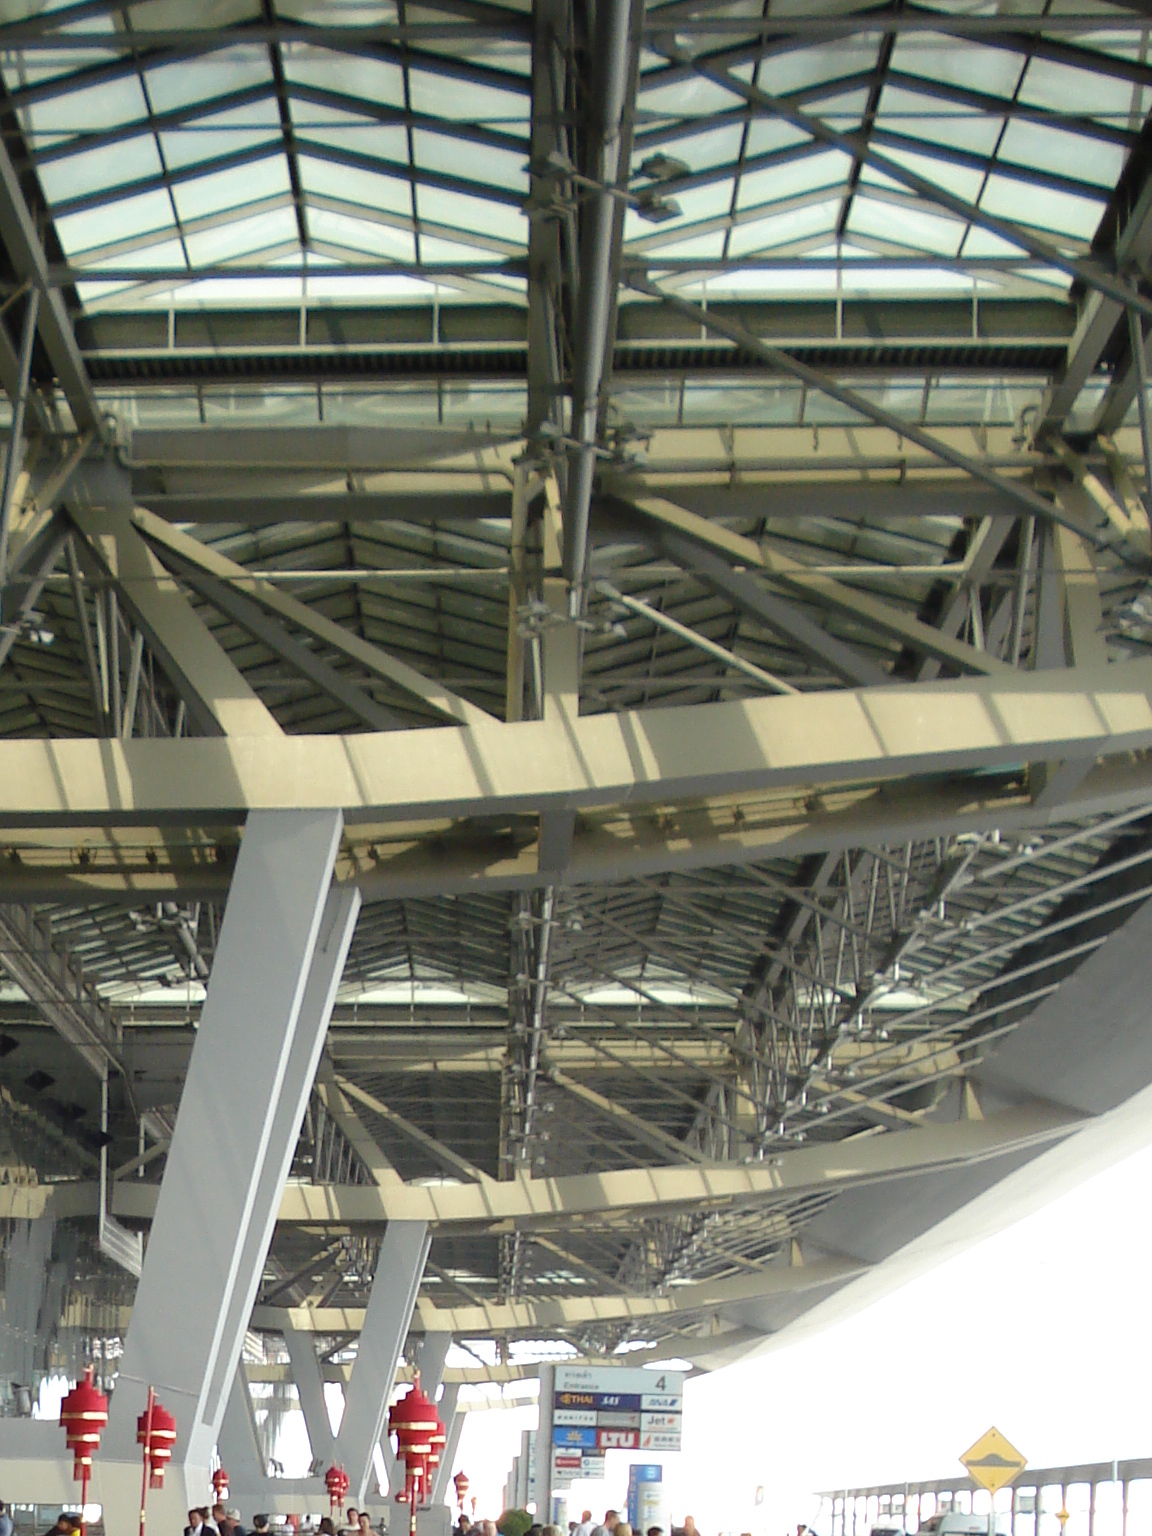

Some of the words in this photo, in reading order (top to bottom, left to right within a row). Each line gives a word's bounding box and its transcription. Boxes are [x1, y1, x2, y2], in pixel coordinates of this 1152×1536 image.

[654, 1375, 666, 1391] 4
[571, 1394, 593, 1403] THAI
[647, 1415, 665, 1425] Jet
[601, 1431, 634, 1447] LTU
